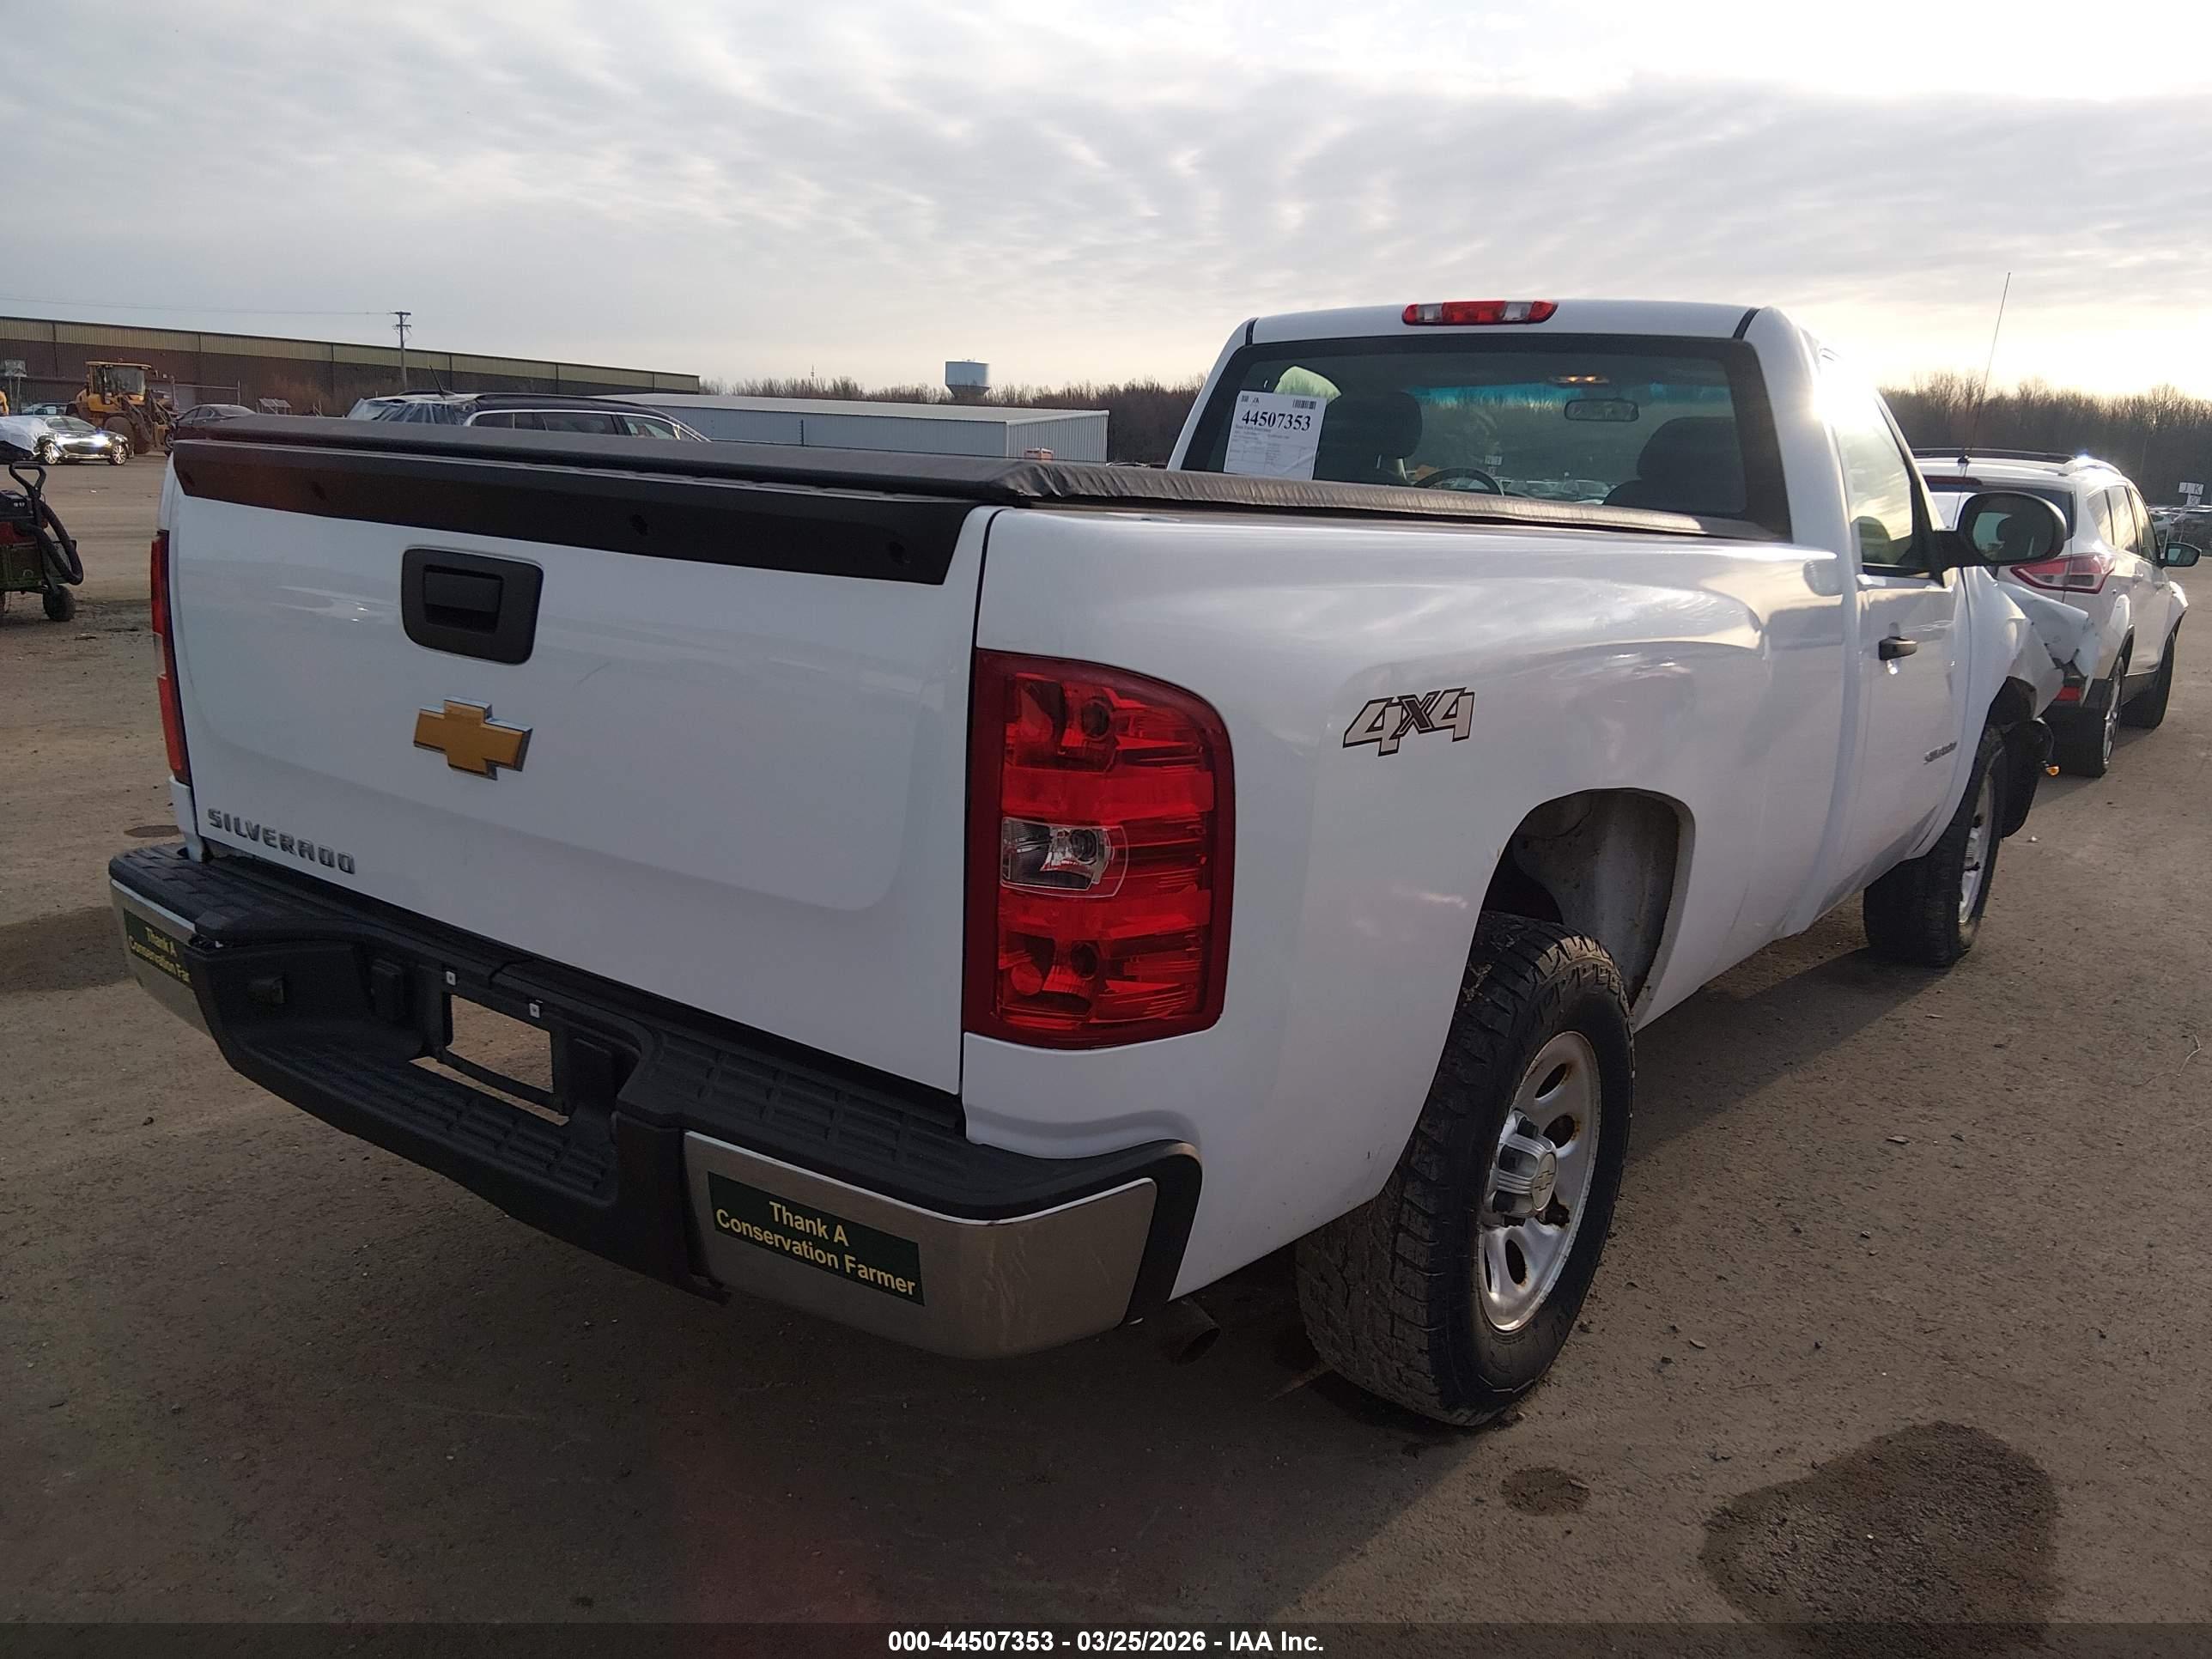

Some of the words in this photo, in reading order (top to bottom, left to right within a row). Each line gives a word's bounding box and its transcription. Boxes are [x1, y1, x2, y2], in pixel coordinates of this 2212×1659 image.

[1242, 410, 1312, 432] 44507353
[208, 808, 356, 875] SILVERADO
[769, 1200, 830, 1240] Thank
[833, 1224, 849, 1247] A
[715, 1208, 839, 1270] Conservation
[843, 1254, 916, 1297] Farmer
